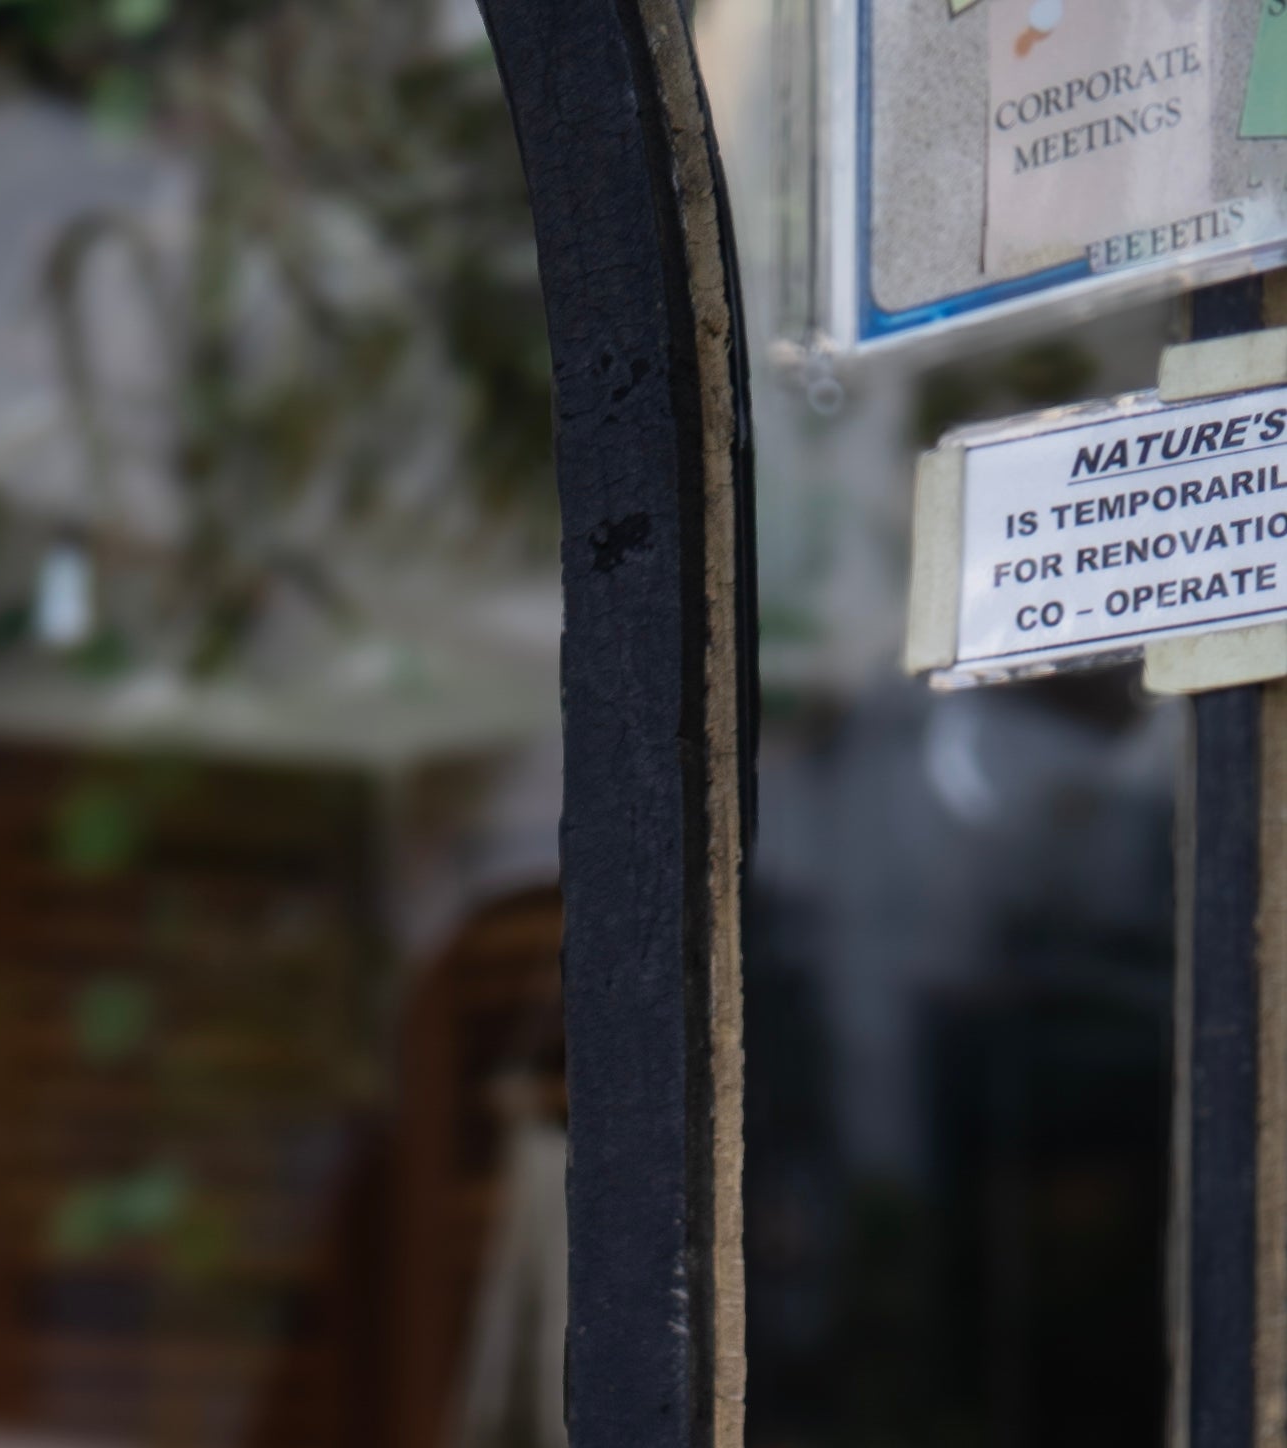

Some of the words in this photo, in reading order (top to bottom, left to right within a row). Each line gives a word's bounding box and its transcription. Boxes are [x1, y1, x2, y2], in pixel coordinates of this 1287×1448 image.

[996, 43, 1201, 132] CORPORATE
[1013, 99, 1183, 176] MEETINGS
[1071, 408, 1287, 478] NATURE'S
[1006, 511, 1039, 539] IS
[993, 554, 1063, 588] FOR
[1016, 601, 1064, 632] CO
[1105, 563, 1278, 617] OPERATE
